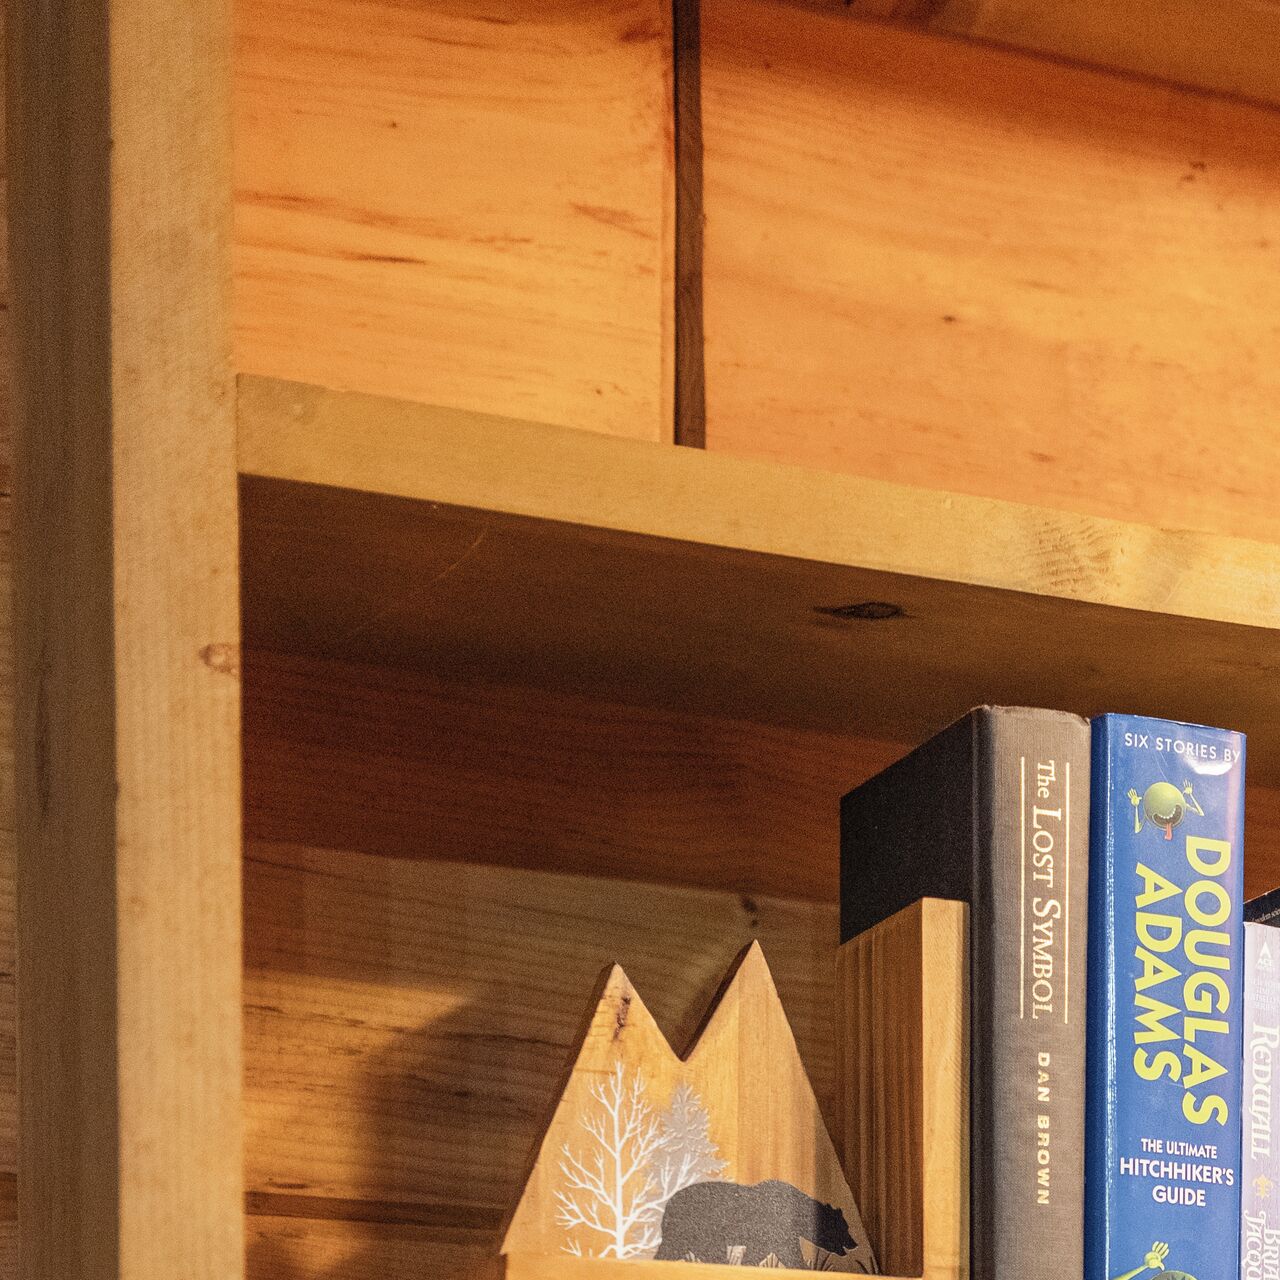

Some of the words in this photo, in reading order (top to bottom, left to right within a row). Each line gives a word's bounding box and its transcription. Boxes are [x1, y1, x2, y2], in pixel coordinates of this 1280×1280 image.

[1123, 731, 1148, 750] SIX
[1154, 737, 1218, 761] STORIES
[1223, 746, 1241, 763] BY
[1037, 760, 1056, 799] The
[1032, 805, 1062, 889] LOST
[1031, 897, 1062, 1020] SYMBOL
[1132, 862, 1183, 1083] ADAMS
[1182, 835, 1233, 1127] DOUGLAS
[1036, 1052, 1051, 1103] DAN
[1036, 1114, 1051, 1206] BROWN
[1119, 1157, 1235, 1187] HITCHHIKER'S
[1140, 1137, 1162, 1154] THE
[1165, 1141, 1218, 1160] ULTIMATE
[1151, 1184, 1206, 1207] GUIDE
